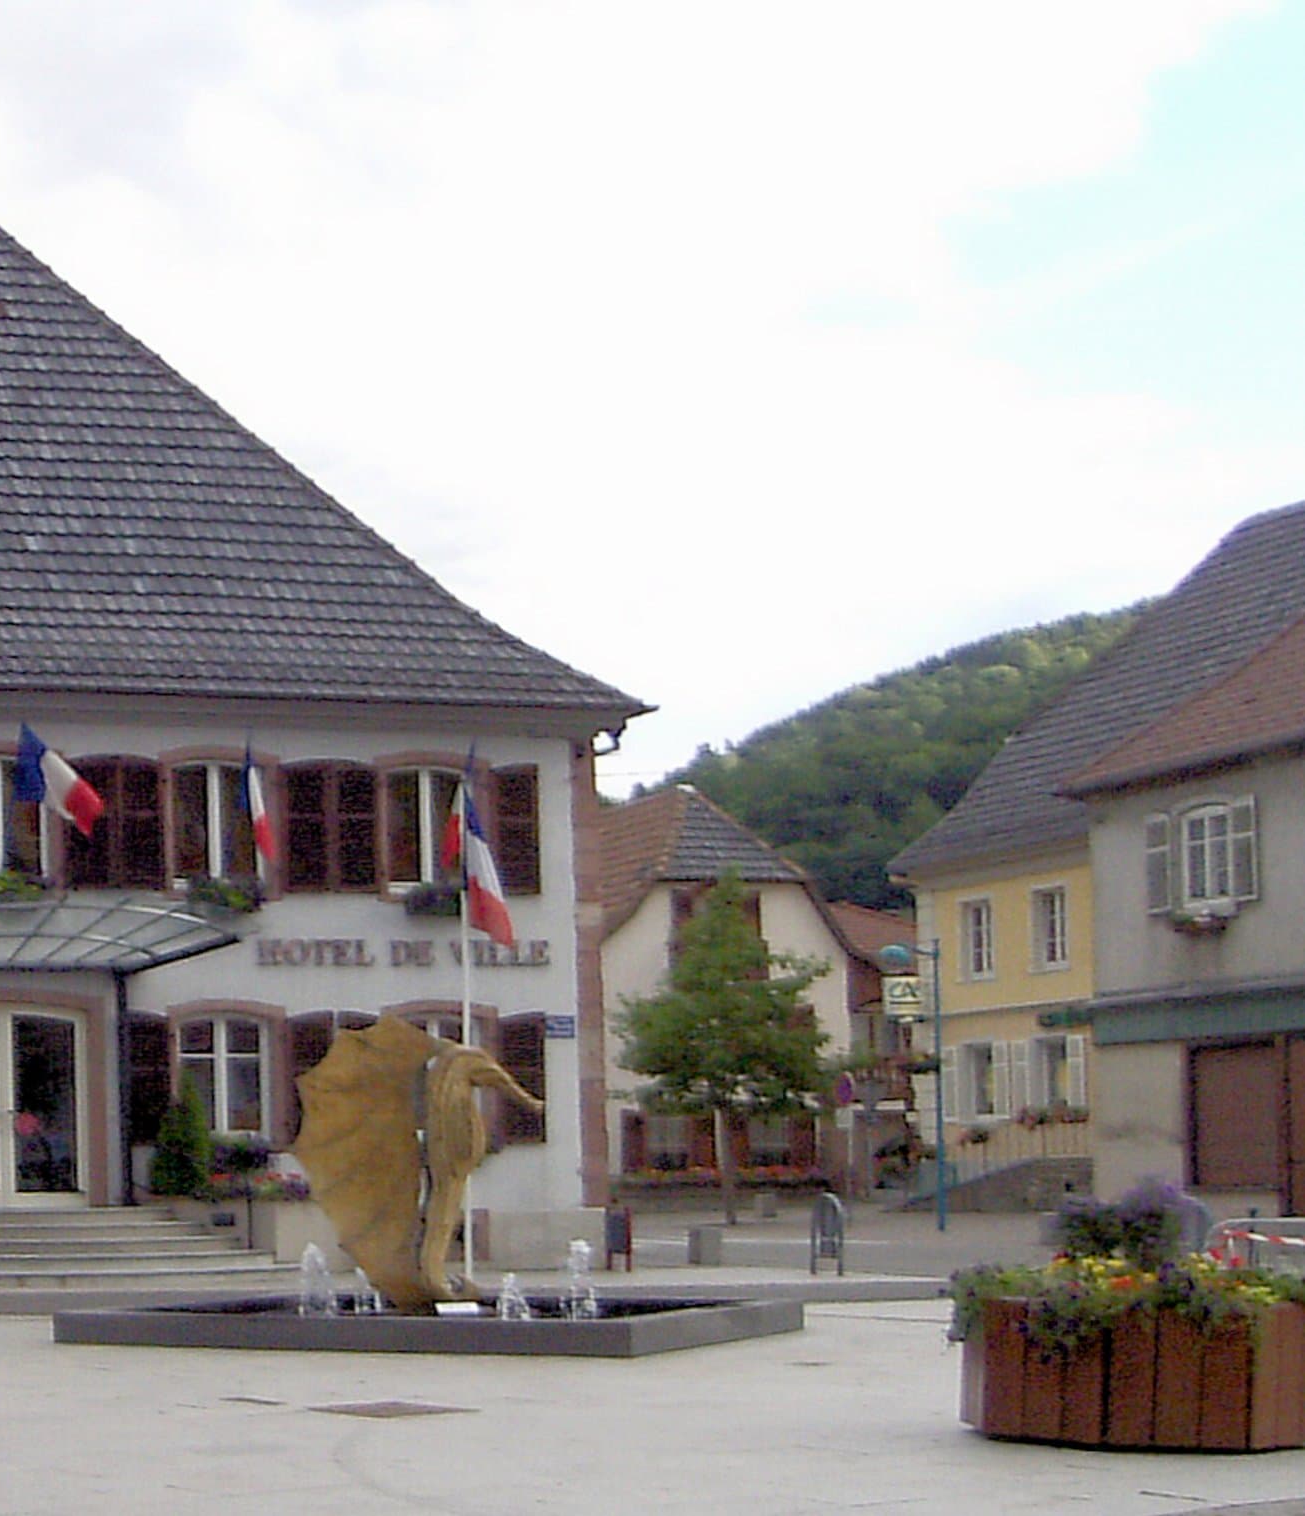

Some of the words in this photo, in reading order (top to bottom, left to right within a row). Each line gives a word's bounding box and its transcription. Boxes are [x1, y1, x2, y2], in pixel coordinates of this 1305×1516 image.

[256, 939, 375, 967] HOTEL
[390, 940, 435, 967] DE
[889, 981, 918, 998] CA
